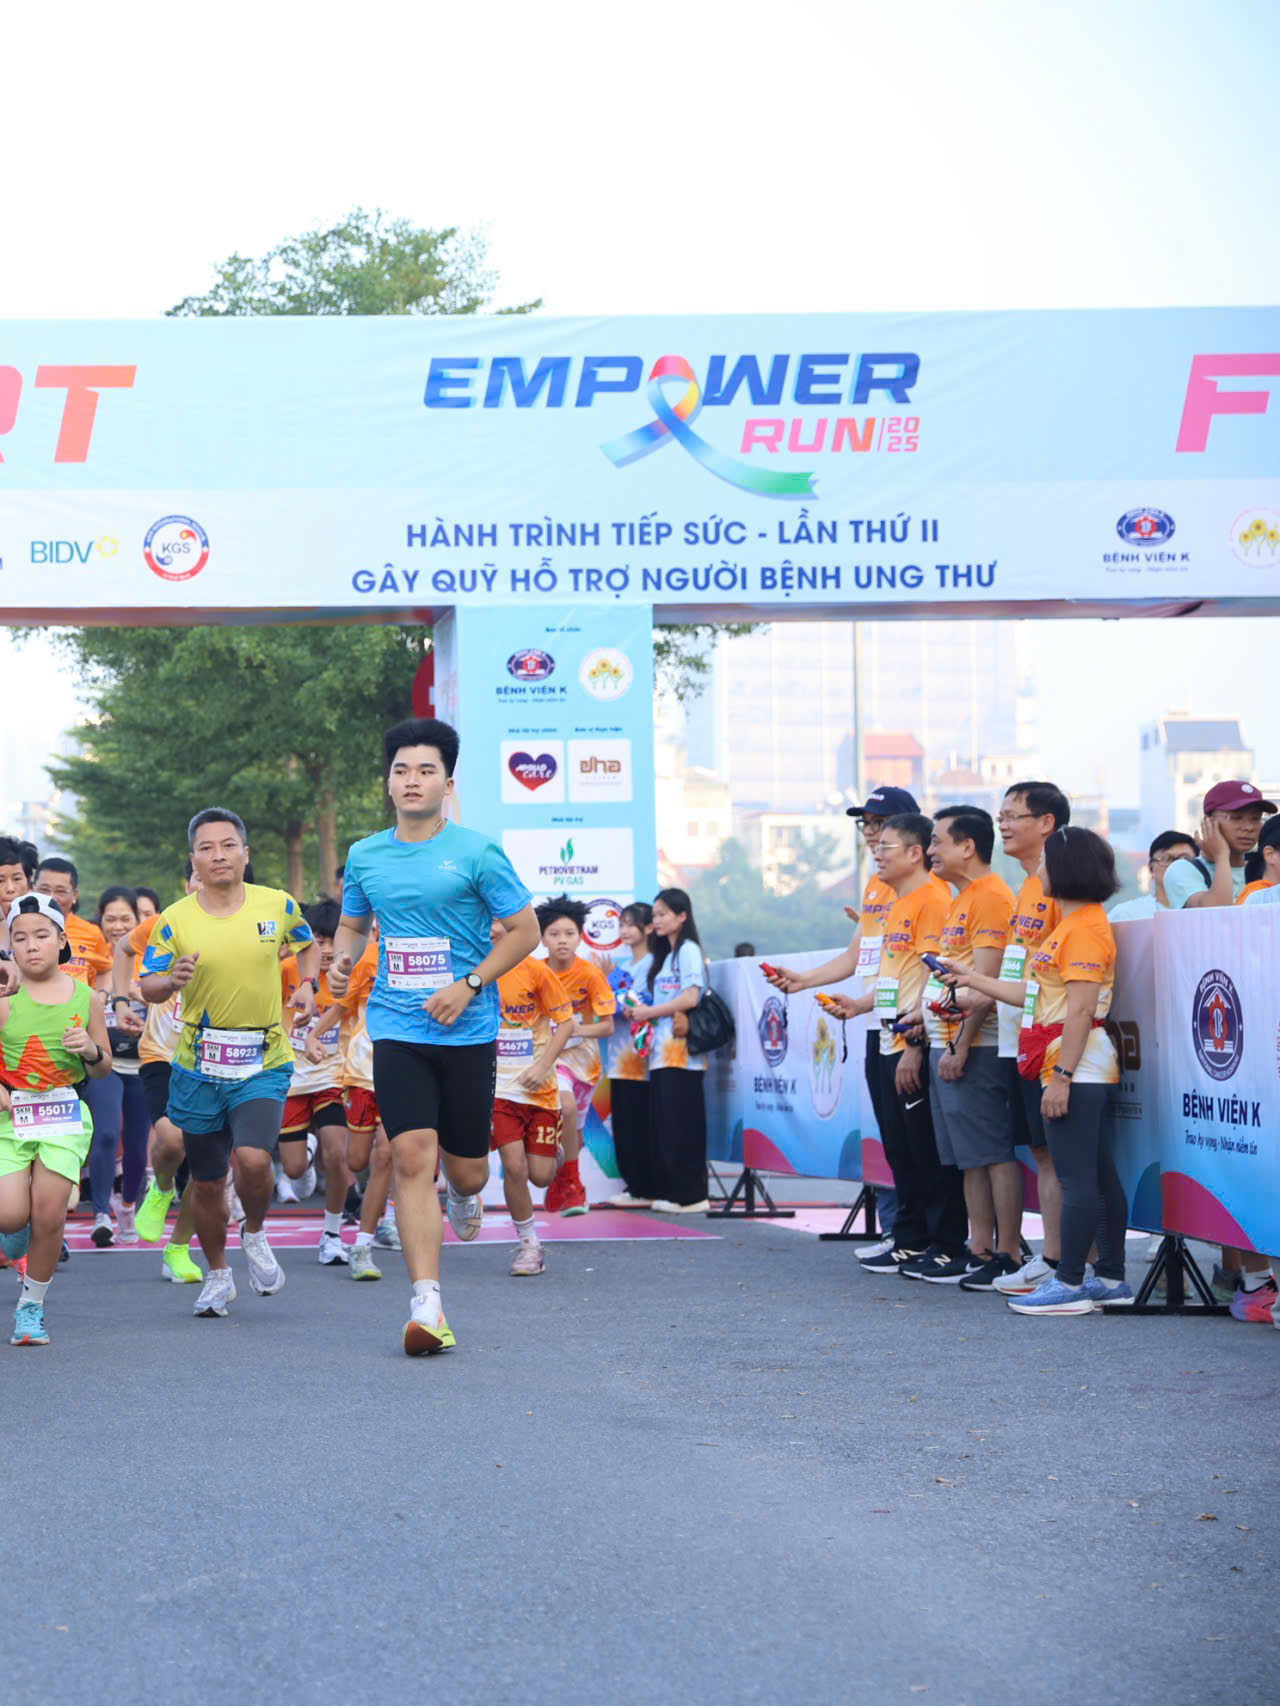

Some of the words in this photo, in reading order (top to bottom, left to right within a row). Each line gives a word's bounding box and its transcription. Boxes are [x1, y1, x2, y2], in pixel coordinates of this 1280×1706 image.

[740, 417, 877, 454] RUN
[407, 516, 498, 548] HÀNH
[509, 515, 600, 547] TRÌNH
[611, 511, 672, 546] TIẾP
[684, 513, 747, 546] SỨC
[778, 508, 838, 545] LẦN
[849, 511, 911, 543] THỨ
[921, 519, 939, 543] II
[30, 540, 94, 563] BIDV
[162, 542, 191, 554] KGS
[351, 562, 420, 594] GÂY
[431, 563, 498, 594] QUỸ
[510, 557, 558, 592] HỖ
[568, 563, 630, 599] TRỢ
[642, 559, 748, 592] NGƯỜI
[760, 559, 841, 597] BỆNH
[854, 563, 924, 590] UNG
[935, 559, 998, 588] THƯ
[393, 963, 400, 971] M
[408, 954, 446, 966] 58075
[208, 1052, 216, 1060] M
[38, 1103, 74, 1116] 55017
[1183, 1088, 1214, 1125] BỆNH
[1217, 1093, 1248, 1131] VIỆN
[1251, 1101, 1261, 1128] K
